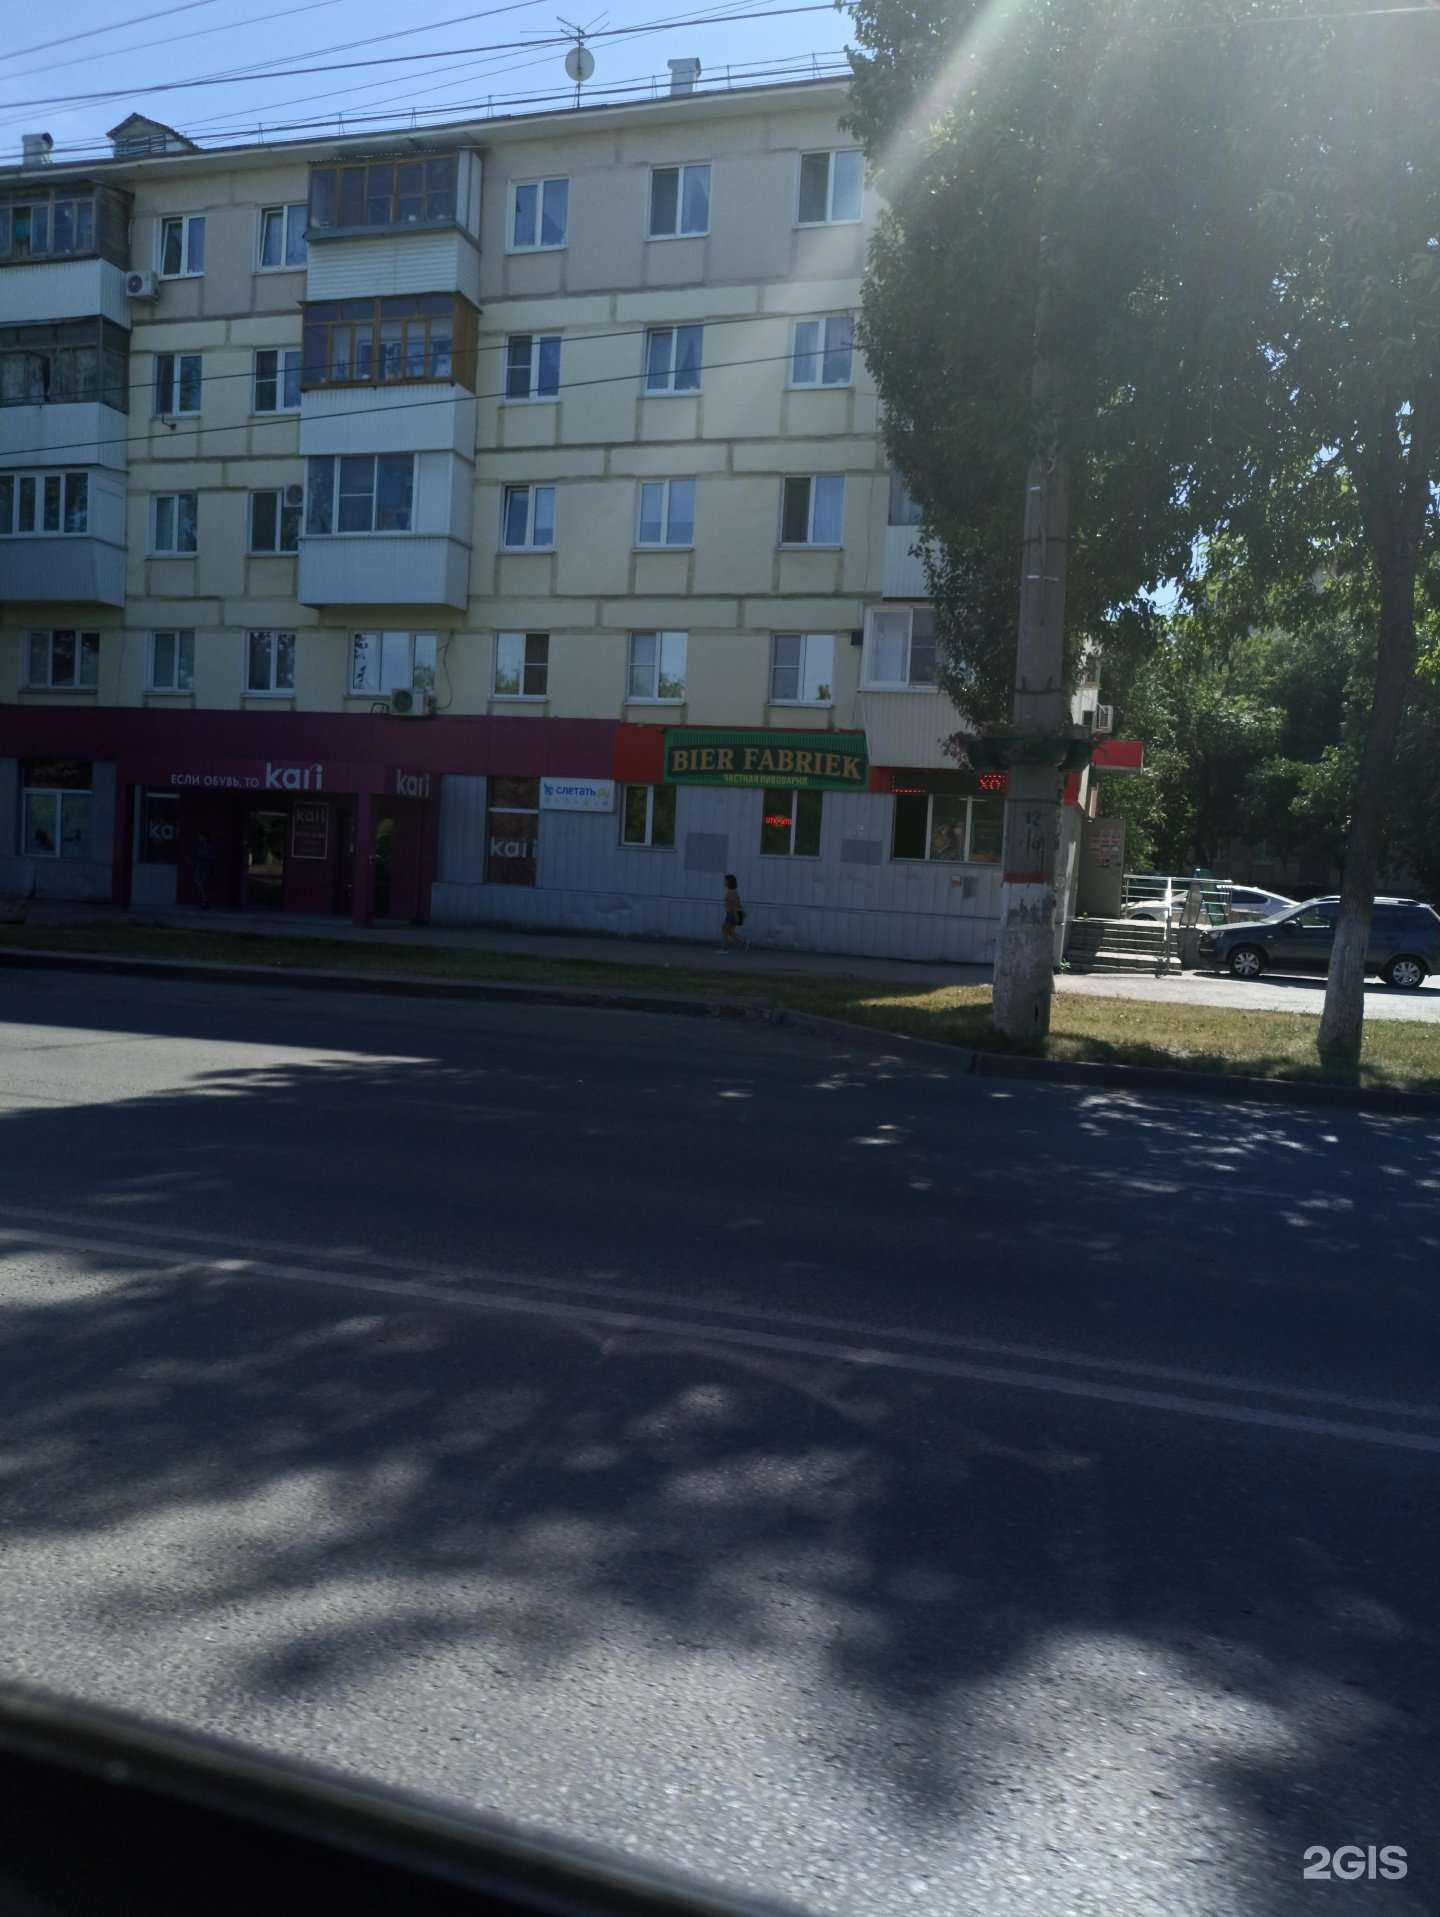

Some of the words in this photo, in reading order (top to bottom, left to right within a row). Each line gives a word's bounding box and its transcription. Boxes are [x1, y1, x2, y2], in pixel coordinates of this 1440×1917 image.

[265, 762, 324, 790] kari
[671, 748, 735, 772] BIER
[743, 748, 862, 780] FABRIEK
[170, 773, 200, 786] ЕСЛИ
[396, 769, 430, 797] kari
[149, 817, 175, 839] ka
